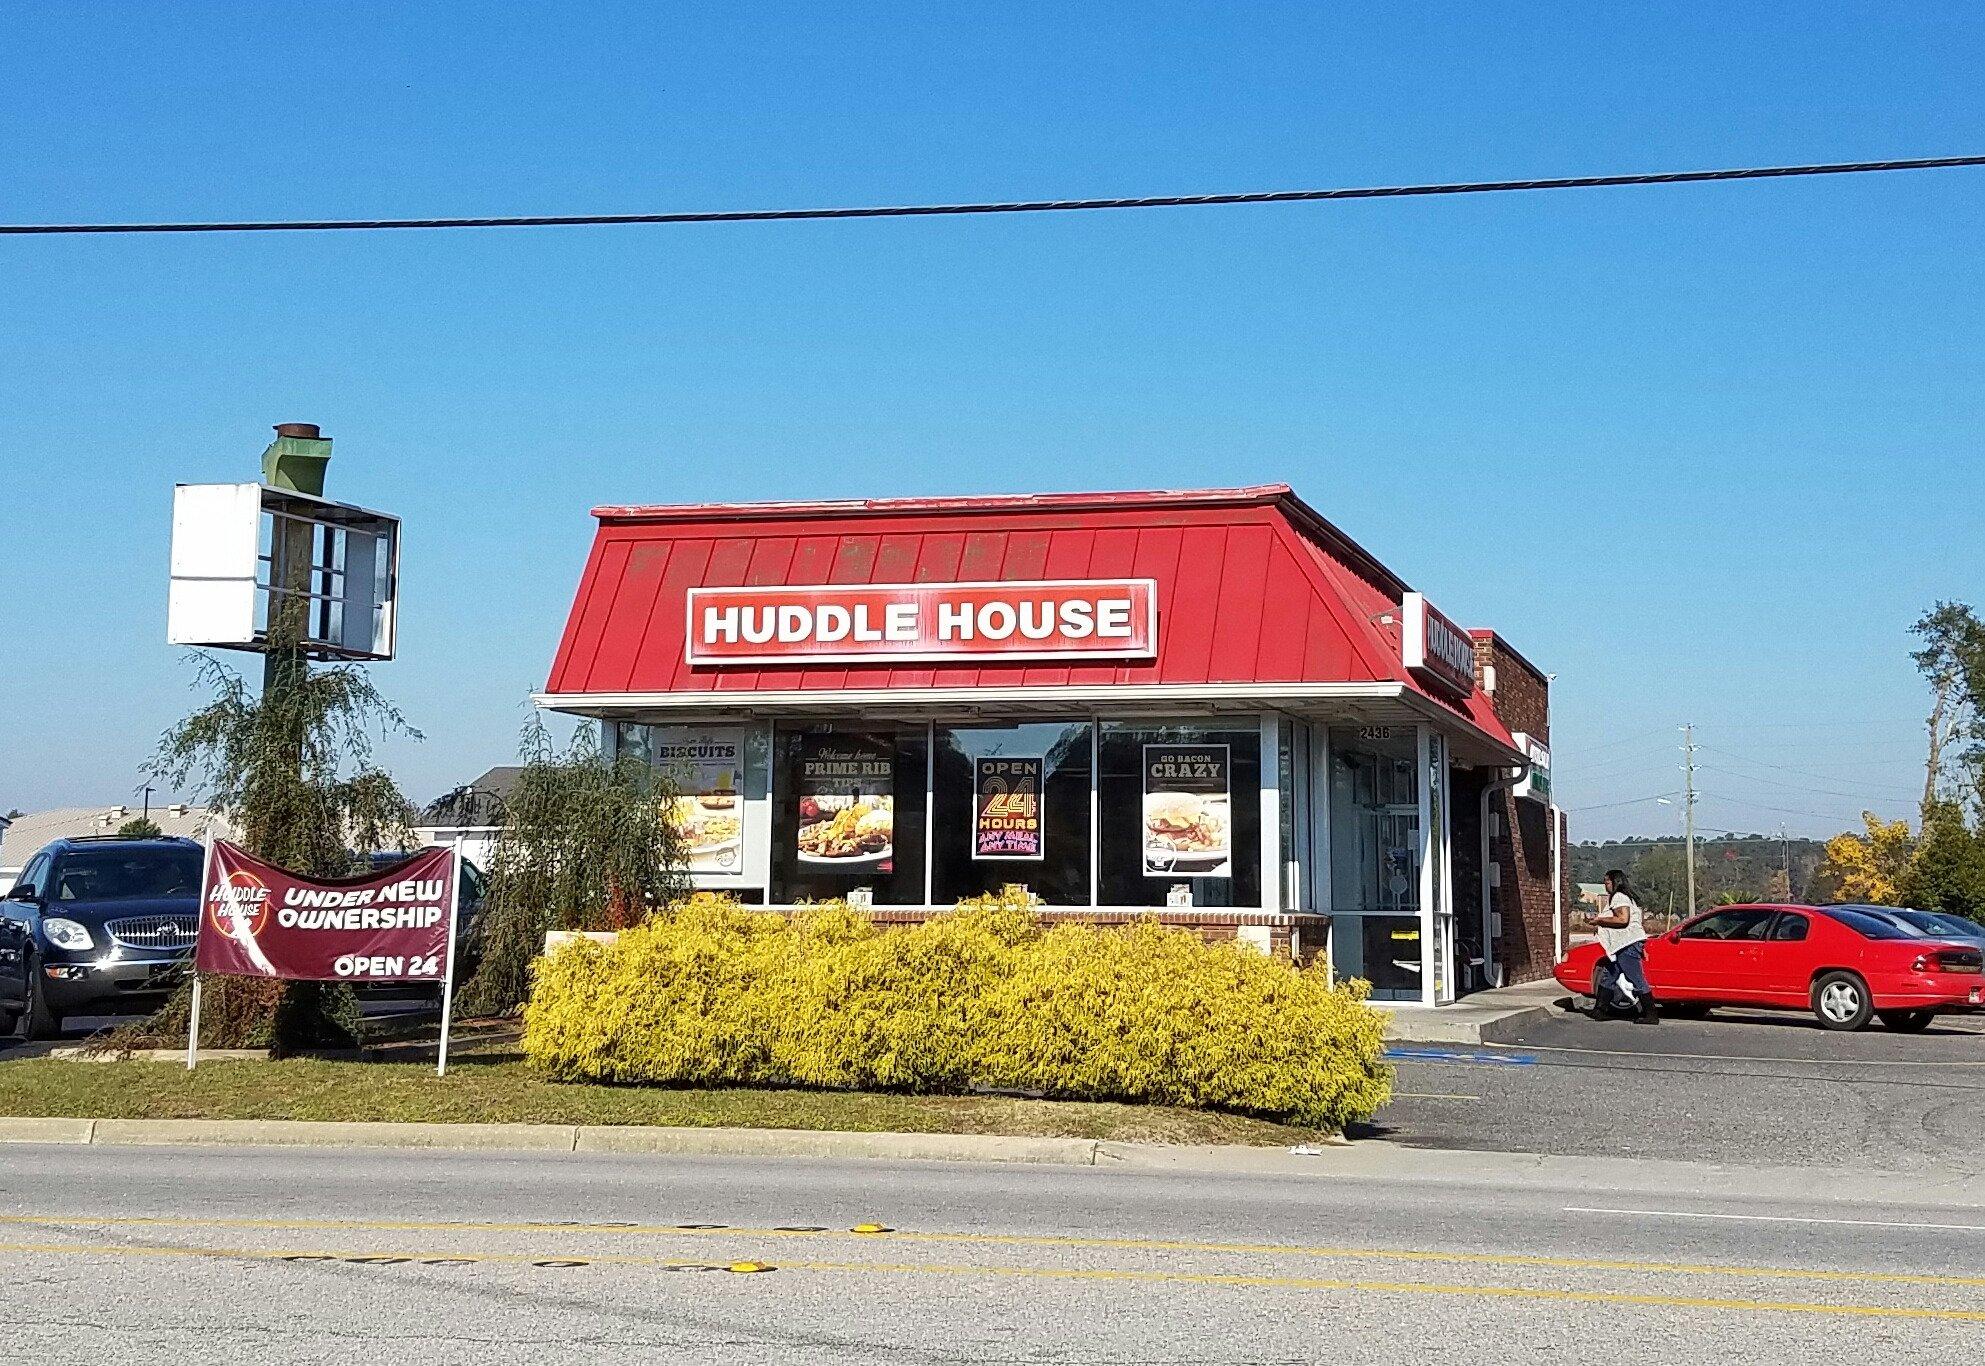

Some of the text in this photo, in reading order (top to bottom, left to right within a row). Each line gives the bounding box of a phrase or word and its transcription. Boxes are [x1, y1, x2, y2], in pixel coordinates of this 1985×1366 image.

[703, 598, 1132, 644] HUDDLE HOUSE
[1360, 726, 1390, 739] 2436
[659, 745, 736, 758] BISCUITS
[1160, 754, 1211, 763] GO BACON
[804, 762, 891, 775] PRIME RIB
[982, 762, 1037, 775] OPEN
[1150, 763, 1221, 778] CRAZY
[980, 776, 1035, 818] 24
[979, 818, 1037, 830] HOURS
[979, 831, 1003, 843] ANY
[980, 840, 1037, 852] ANY TIME
[209, 884, 271, 902] HUDDLE
[284, 879, 443, 908] UNDER NEW
[217, 902, 262, 917] HOUSE
[277, 906, 442, 930] OWNERSHIP
[334, 956, 439, 977] OPEN 24
